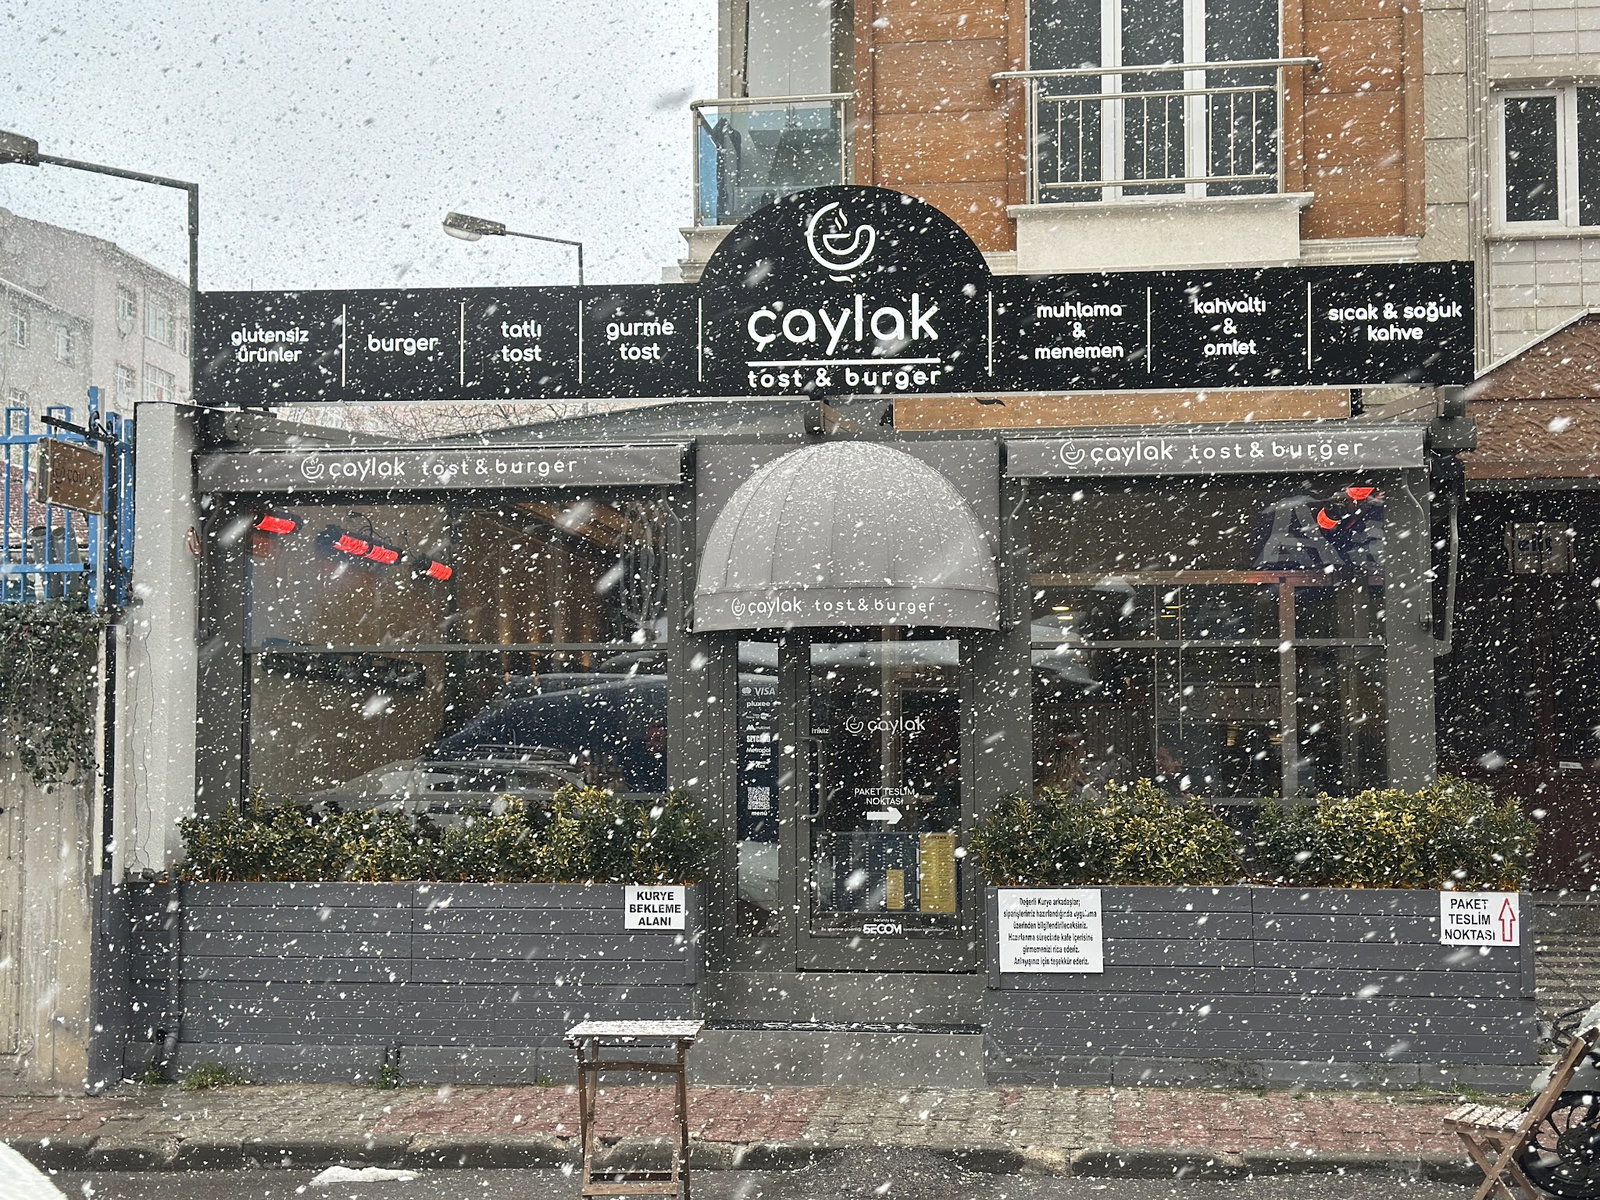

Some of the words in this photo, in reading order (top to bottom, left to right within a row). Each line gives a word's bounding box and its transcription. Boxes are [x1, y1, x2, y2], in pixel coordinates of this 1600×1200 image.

[1036, 300, 1123, 319] muhlama
[1193, 296, 1267, 315] kahvaltı
[1328, 304, 1379, 322] sıcak
[1383, 303, 1398, 320] &
[1403, 301, 1463, 323] soğuk
[501, 320, 542, 339] tatlı
[606, 321, 675, 343] gurme
[747, 293, 938, 356] çaylak
[1072, 321, 1087, 338] &
[1222, 318, 1237, 335] &
[1366, 323, 1423, 342] kahve
[231, 325, 309, 346] glutensiz
[367, 333, 438, 356] burger
[237, 344, 302, 363] ürünler
[501, 344, 542, 362] tost
[619, 341, 661, 361] tost
[1035, 343, 1124, 360] menemen
[1203, 338, 1257, 357] omlet
[747, 369, 803, 388] tost
[815, 368, 832, 388] &
[845, 367, 942, 390] burger
[1090, 441, 1173, 466] çaylak
[1191, 443, 1242, 461] tost
[1250, 441, 1265, 458] &
[1271, 440, 1363, 462] burger
[329, 456, 405, 482] çaylak
[422, 460, 469, 477] tost
[475, 458, 488, 476] &
[495, 456, 577, 479] burger
[748, 596, 803, 618] çaylak
[815, 599, 853, 612] tost
[858, 598, 869, 612] &
[874, 597, 935, 614] burger
[754, 687, 776, 696] VISA
[746, 700, 771, 708] pluxee
[867, 716, 926, 735] çaylak
[854, 787, 881, 796] PAKET
[865, 797, 904, 806] NOKTASI
[636, 891, 675, 901] KURYE
[1038, 898, 1052, 907] Kurye
[1450, 898, 1488, 910] PAKET
[629, 904, 682, 914] BEKLEME
[1448, 911, 1491, 925] TESLİM
[638, 916, 672, 926] ALANI
[863, 923, 902, 935] SECOM
[1061, 933, 1072, 942] kafe
[1444, 929, 1496, 941] NOKTASI
